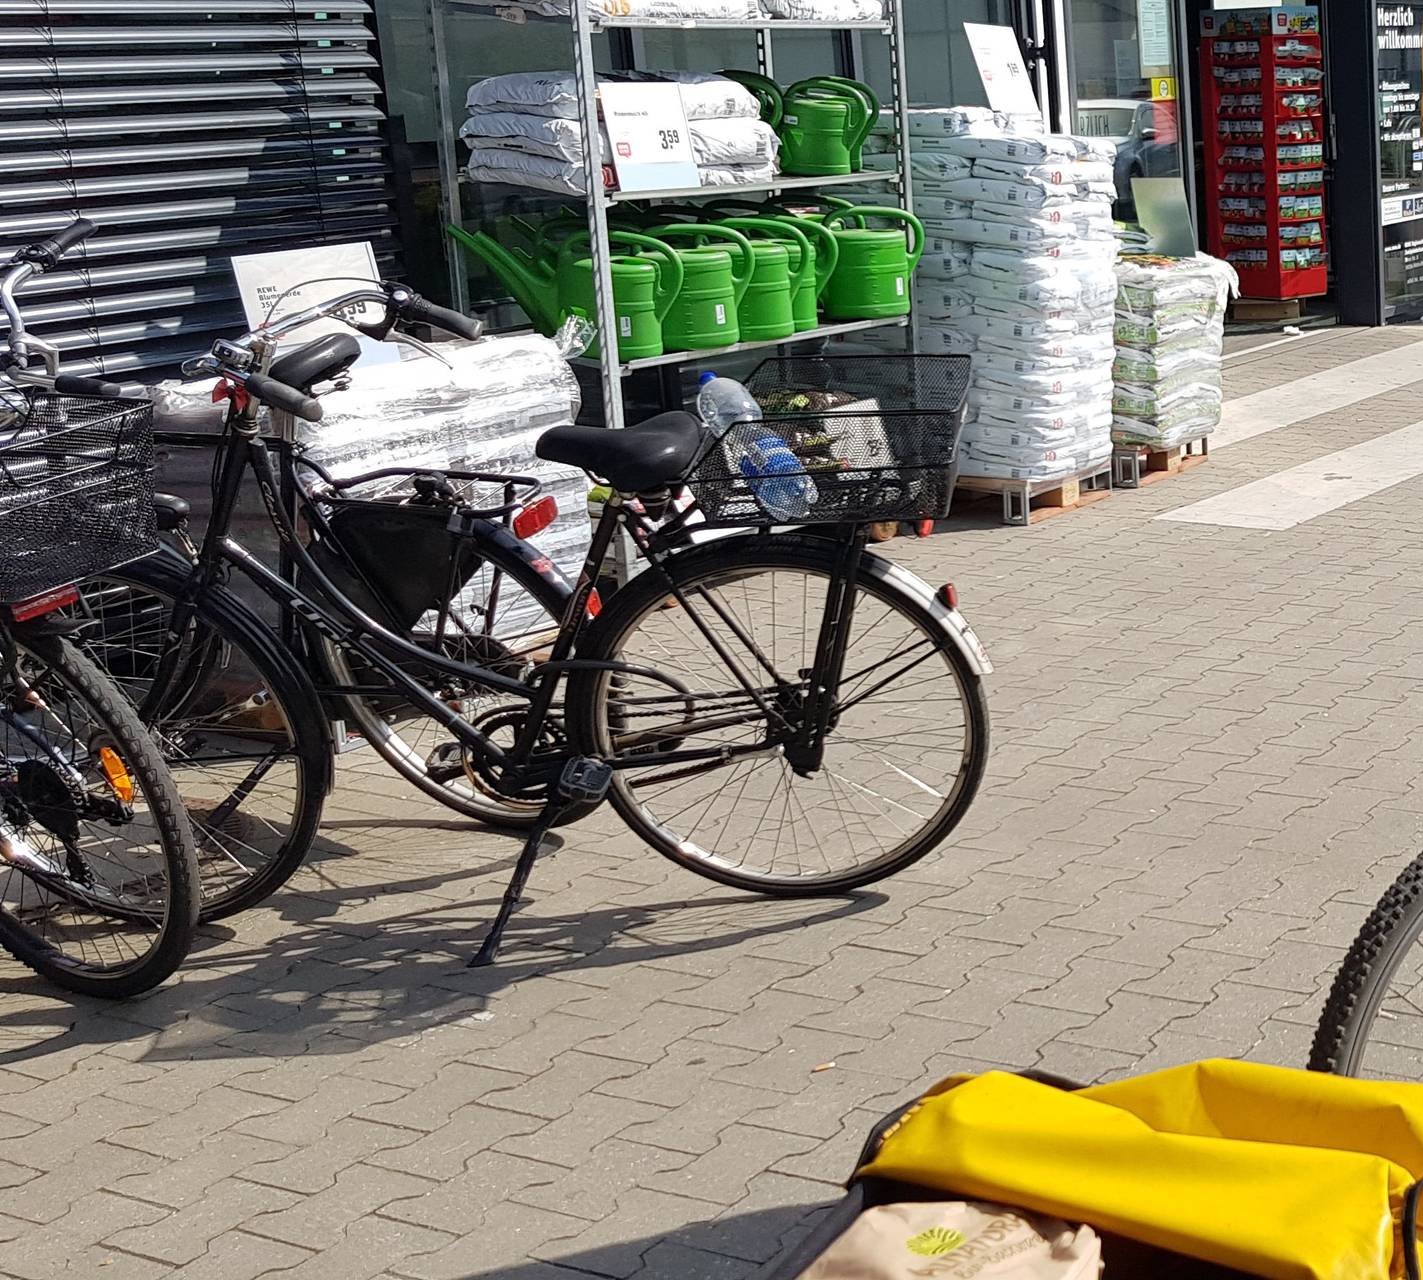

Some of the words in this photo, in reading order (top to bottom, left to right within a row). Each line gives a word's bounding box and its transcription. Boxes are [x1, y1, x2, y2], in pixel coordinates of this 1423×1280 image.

[1377, 7, 1414, 26] Herzlich
[256, 286, 277, 294] REWE
[258, 290, 302, 302] Blumeerde
[290, 598, 396, 686] Union
